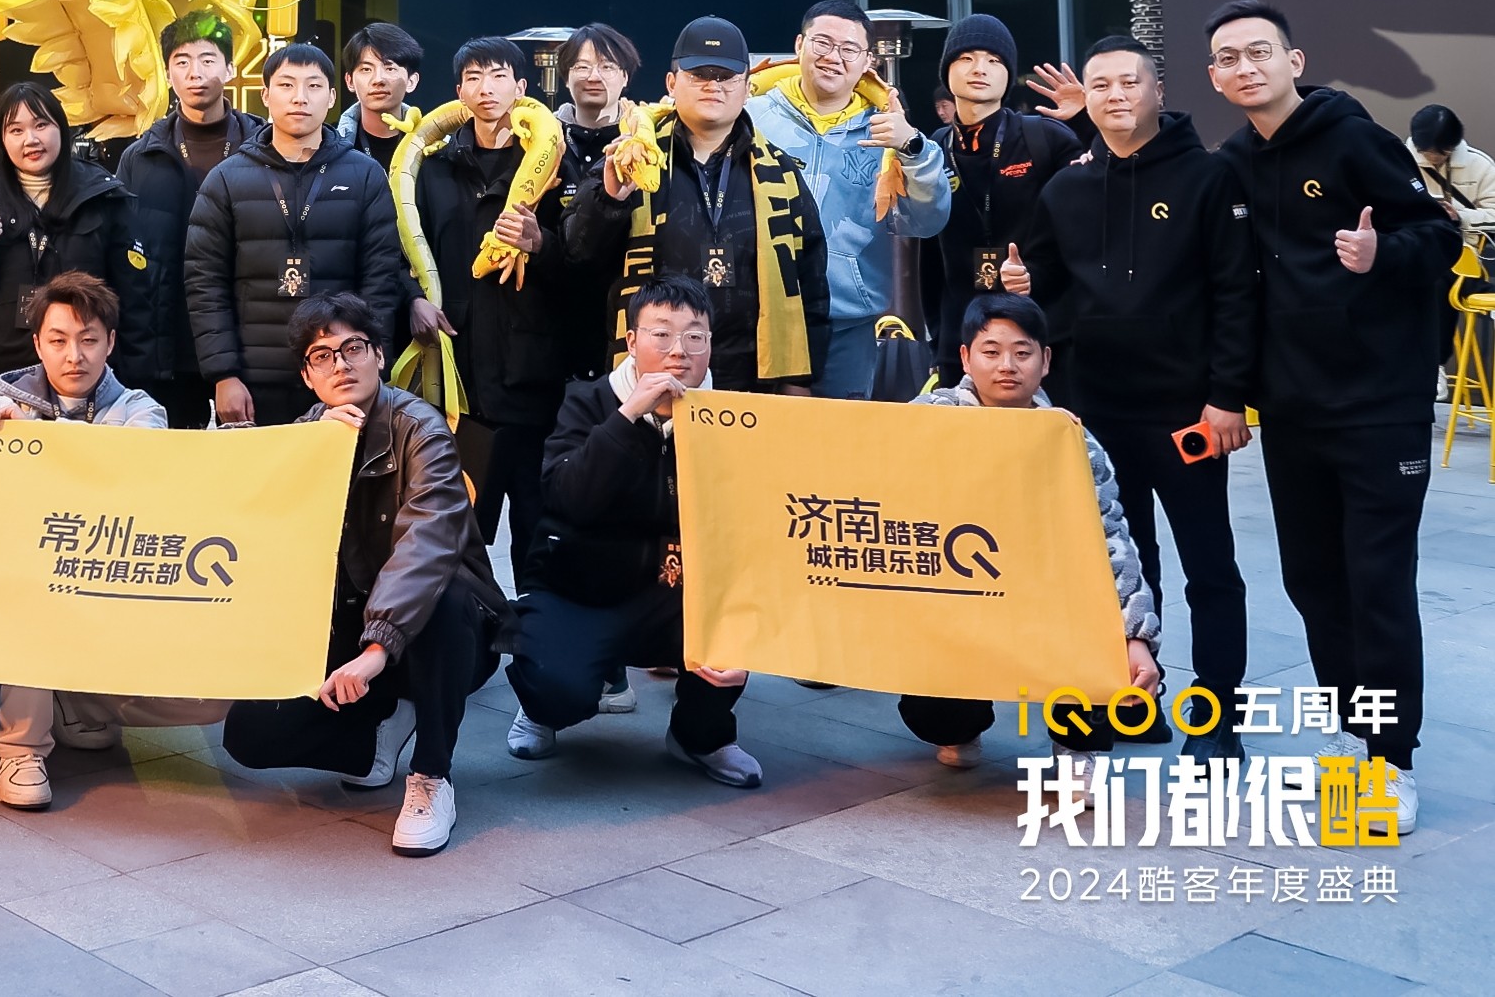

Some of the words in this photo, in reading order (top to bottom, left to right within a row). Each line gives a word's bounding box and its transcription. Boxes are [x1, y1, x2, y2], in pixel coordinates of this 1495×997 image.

[689, 404, 758, 429] iQOO
[51, 554, 183, 586] 城市俱乐部
[805, 542, 943, 577] 城市俱乐部
